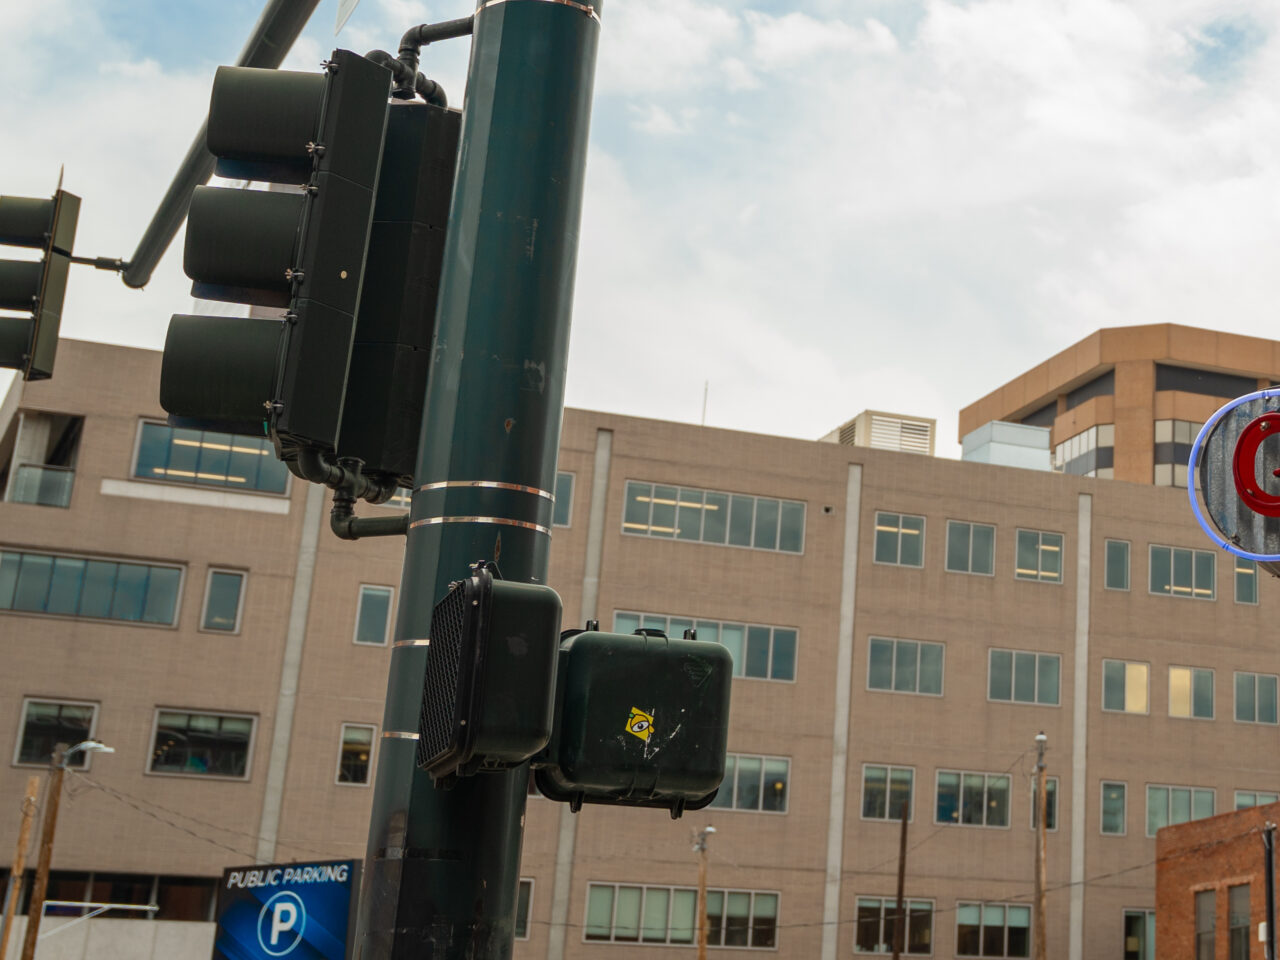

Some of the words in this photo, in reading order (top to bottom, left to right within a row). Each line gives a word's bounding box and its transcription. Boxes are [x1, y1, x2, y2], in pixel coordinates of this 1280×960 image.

[226, 869, 282, 889] PUBLIC
[282, 864, 349, 885] PARKING
[270, 902, 297, 945] P
